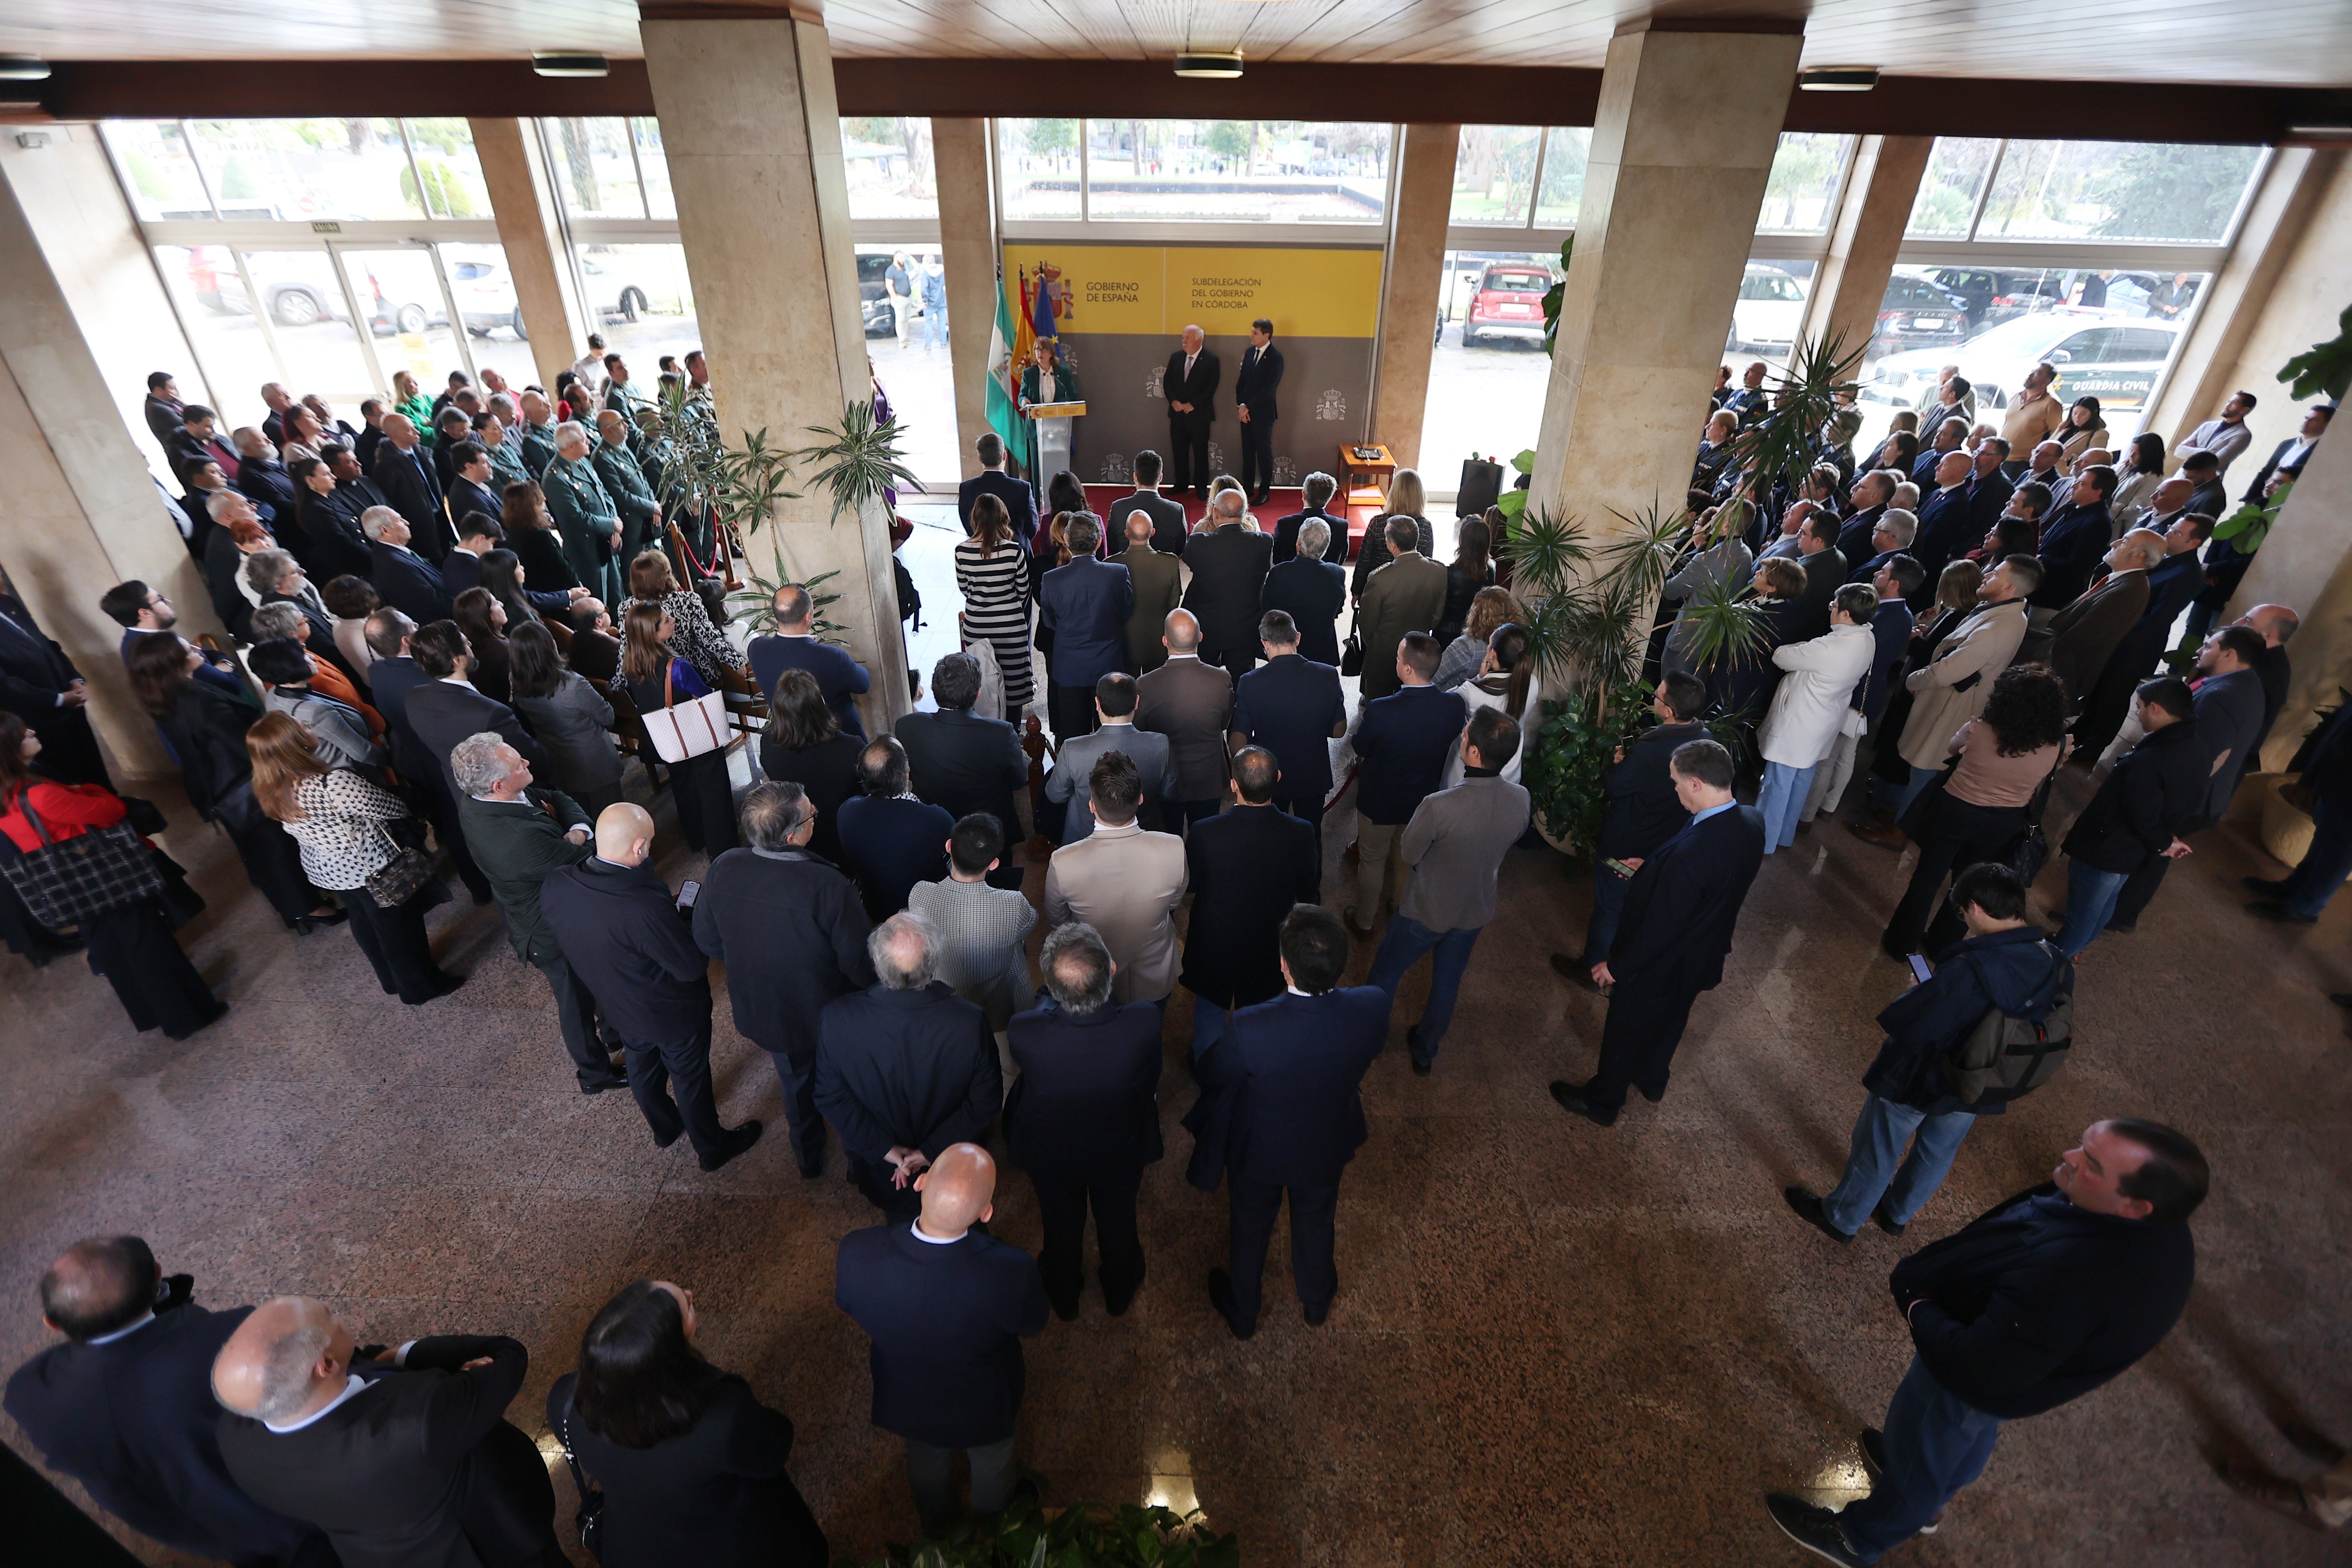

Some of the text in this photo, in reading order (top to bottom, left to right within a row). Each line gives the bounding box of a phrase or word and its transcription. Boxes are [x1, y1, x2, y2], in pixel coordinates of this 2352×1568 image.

[1192, 277, 1261, 286] SUBDELEGACIÓN
[1086, 282, 1139, 291] GOBIERNO
[1087, 292, 1138, 302] DE ESPAÑA
[1205, 299, 1248, 308] CÓRDOBA
[2072, 381, 2150, 391] GUARDIA CIVIL
